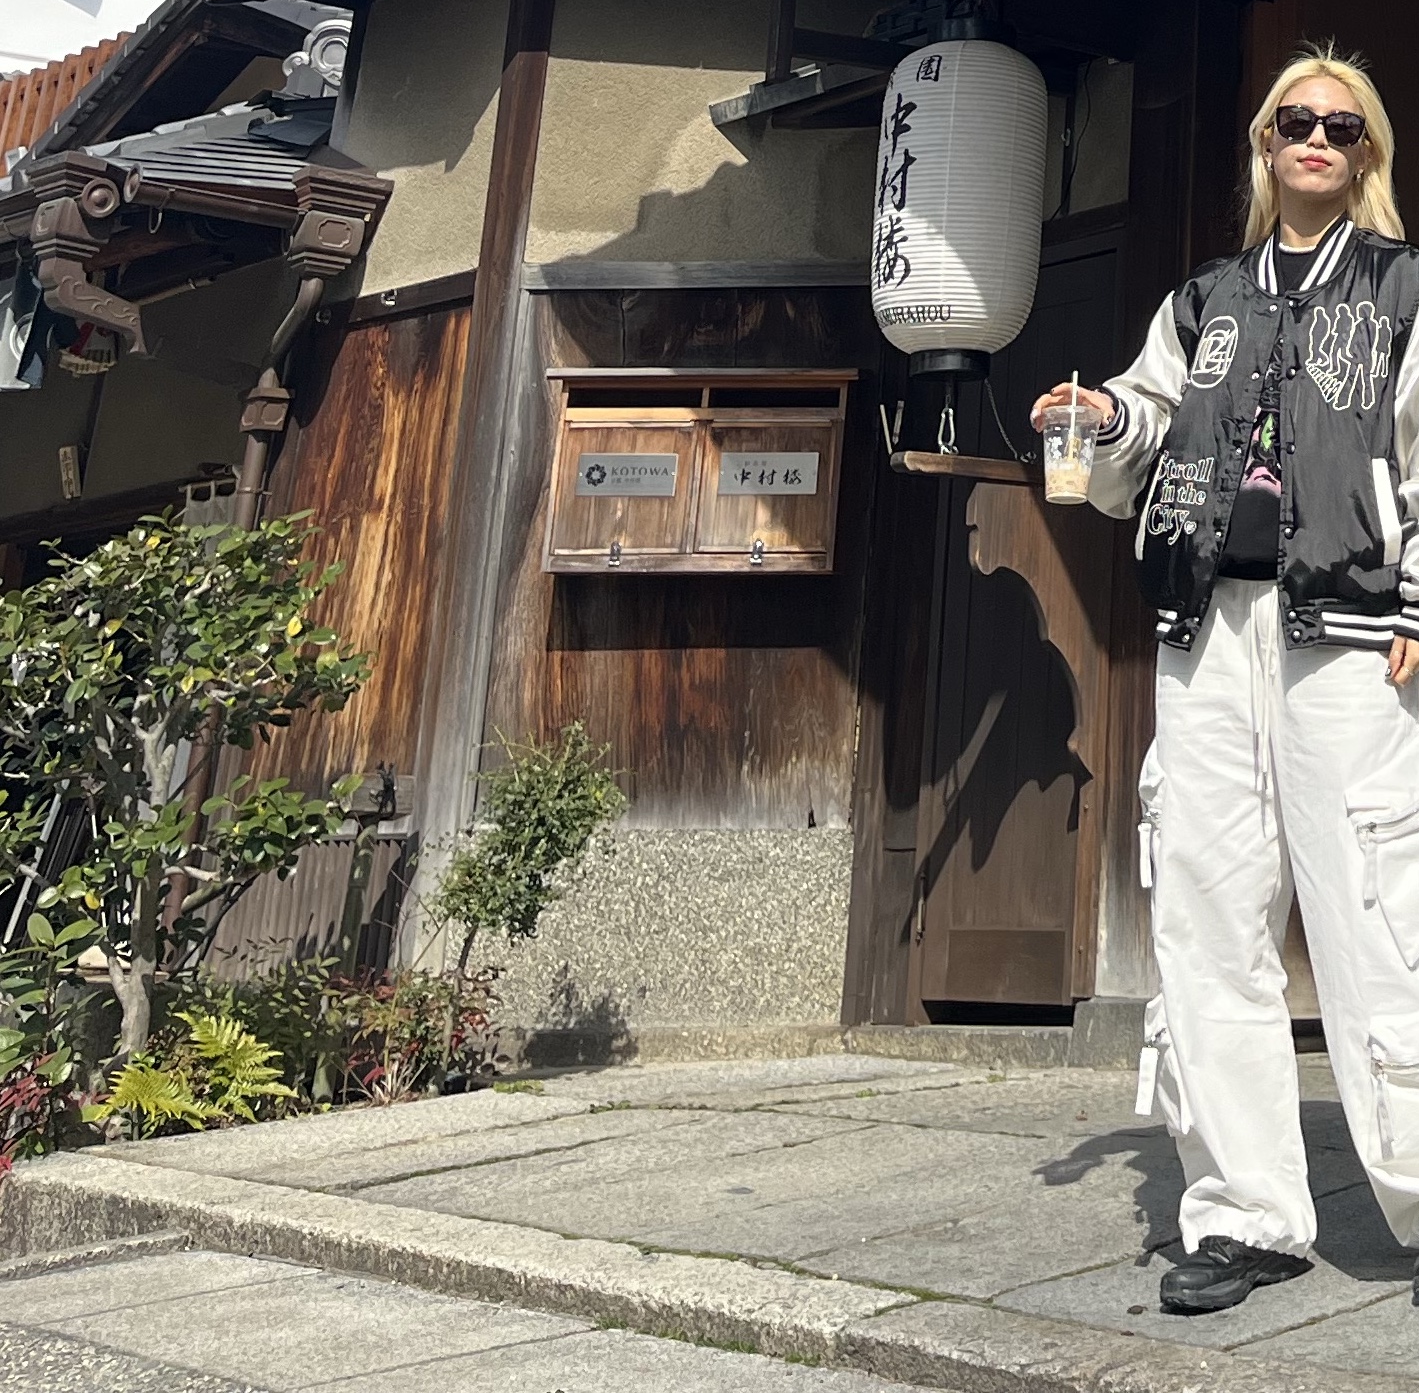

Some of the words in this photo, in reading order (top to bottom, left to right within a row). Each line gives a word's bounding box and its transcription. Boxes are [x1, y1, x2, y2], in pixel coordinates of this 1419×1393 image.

[916, 54, 943, 83] 園
[611, 466, 669, 477] KOTOWA
[1160, 479, 1175, 502] in
[1177, 482, 1206, 505] the
